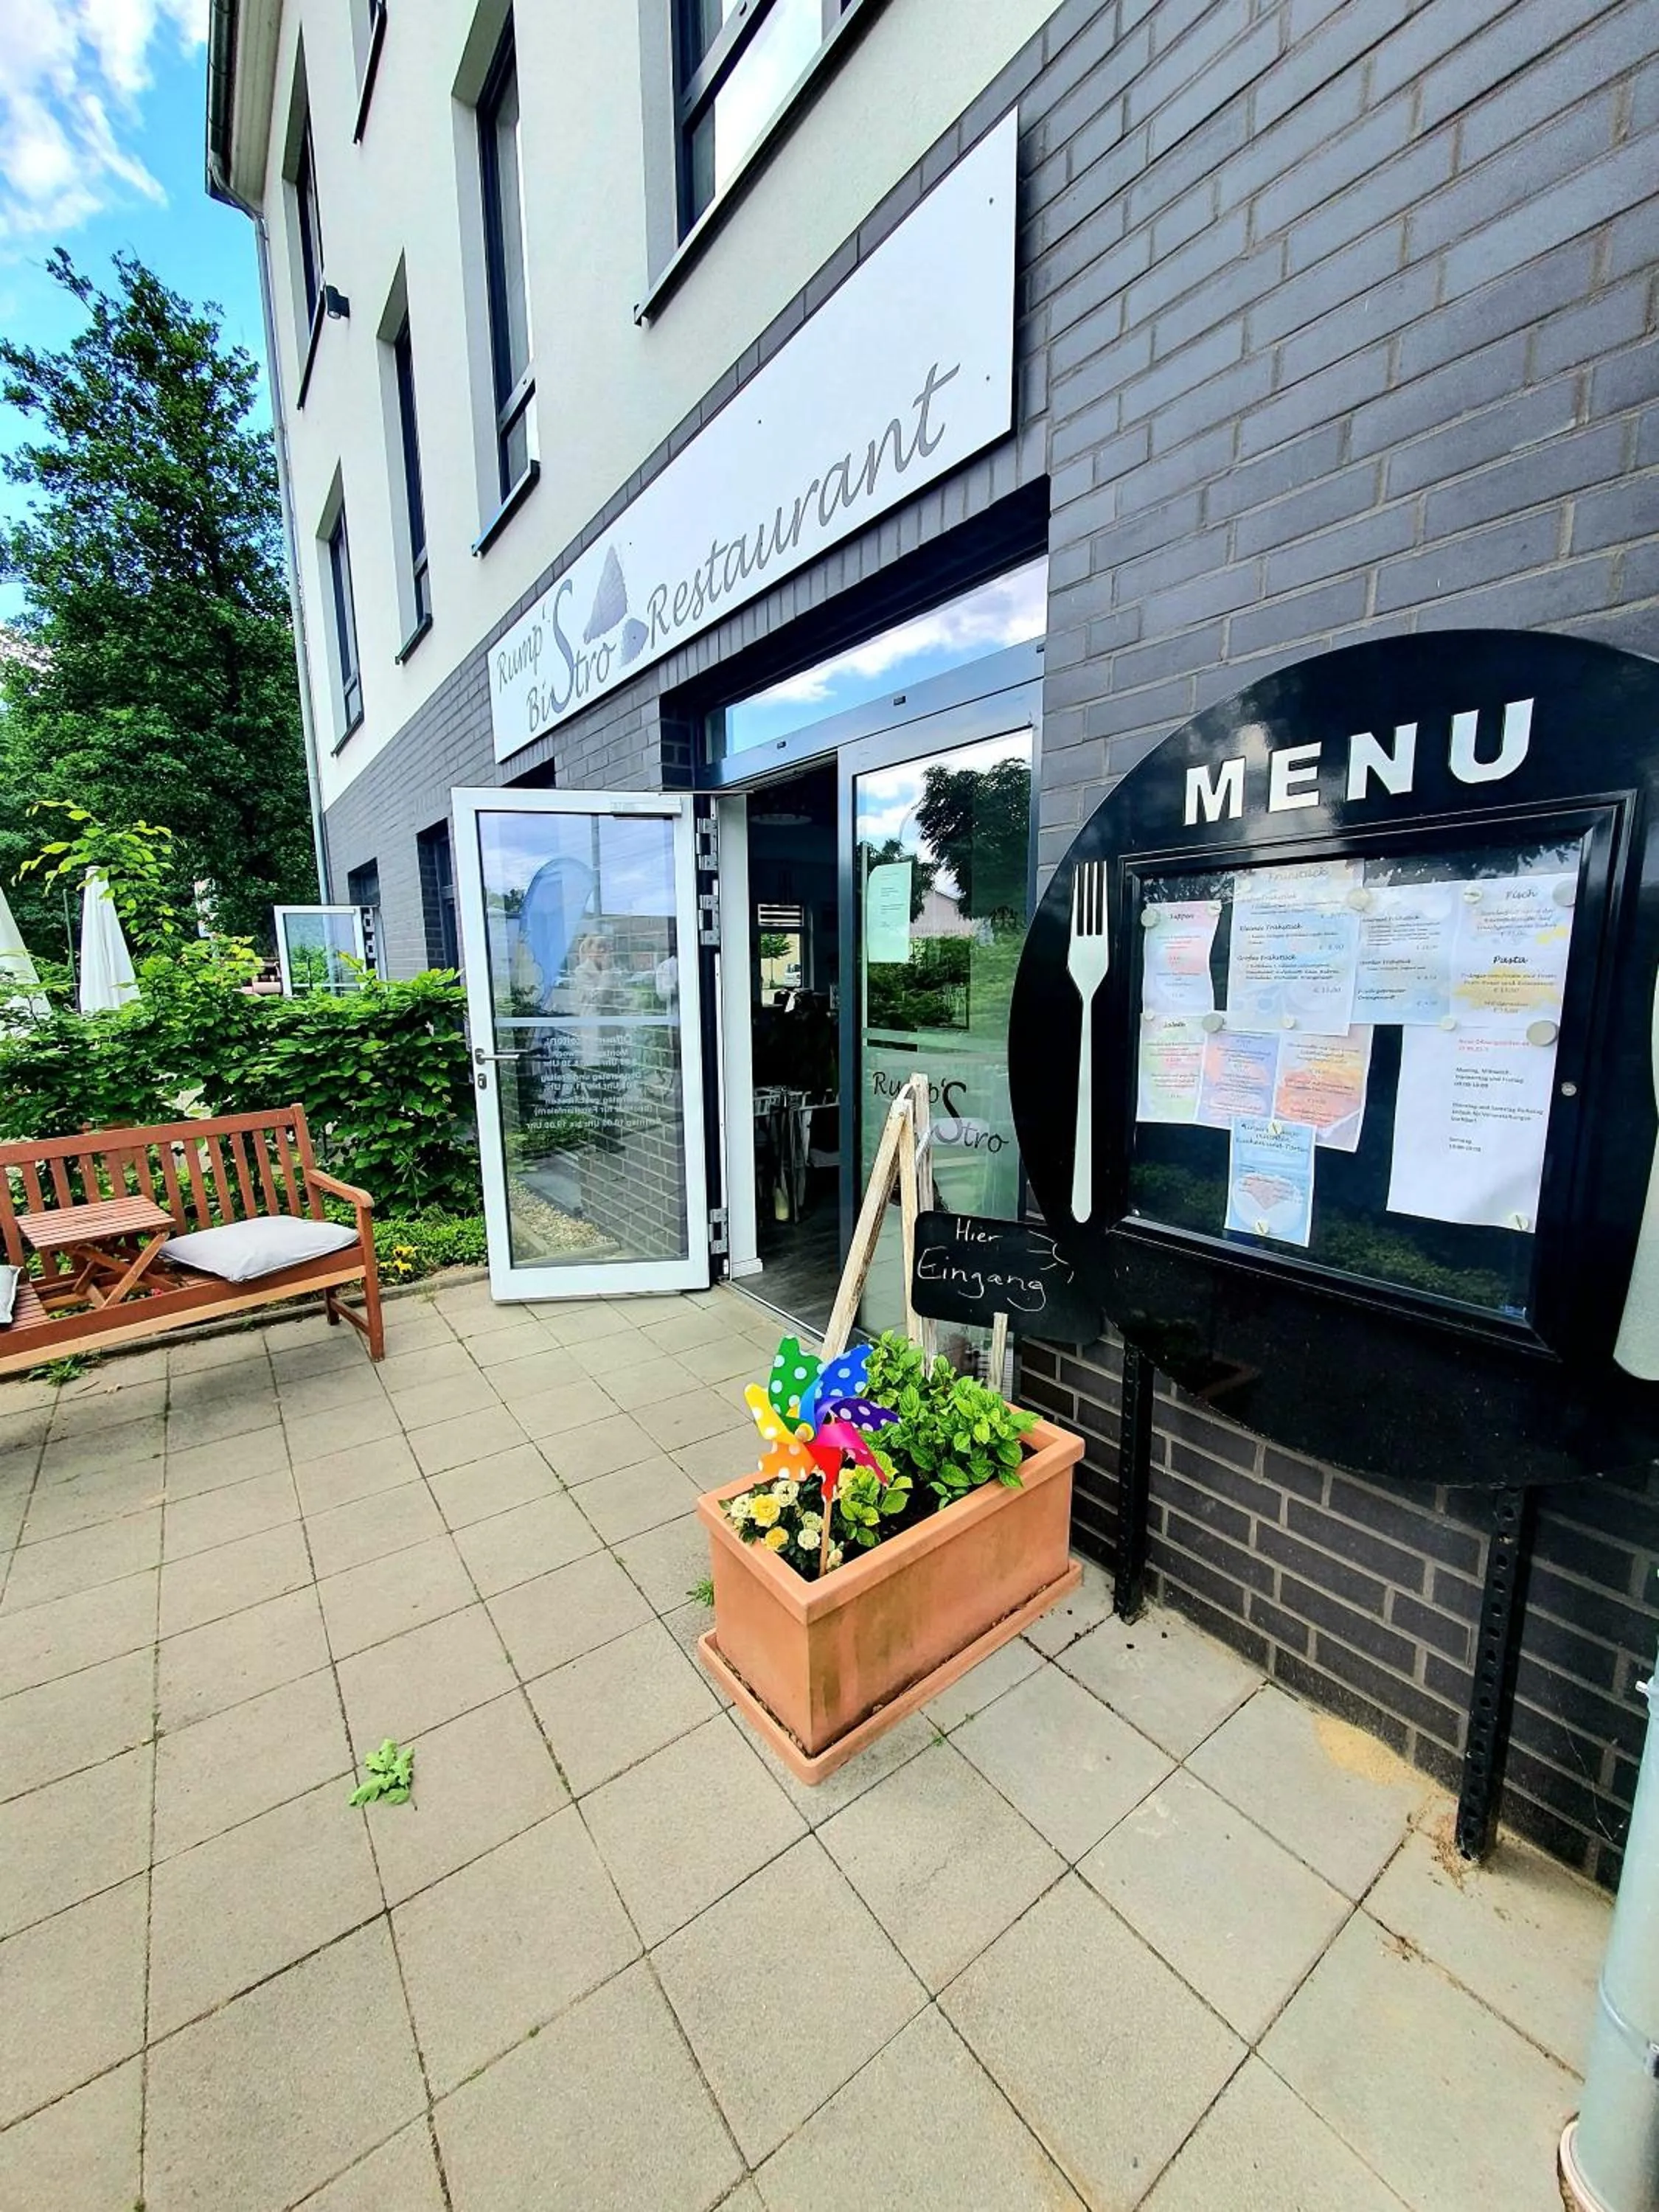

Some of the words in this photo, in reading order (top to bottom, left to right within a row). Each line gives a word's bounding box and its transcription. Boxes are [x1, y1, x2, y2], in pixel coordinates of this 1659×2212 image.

[646, 362, 960, 649] Restaurant
[1183, 697, 1534, 827] MENU
[1493, 955, 1528, 964] Pasta
[956, 1217, 1003, 1242] Hier
[917, 1245, 1046, 1312] Eingang
